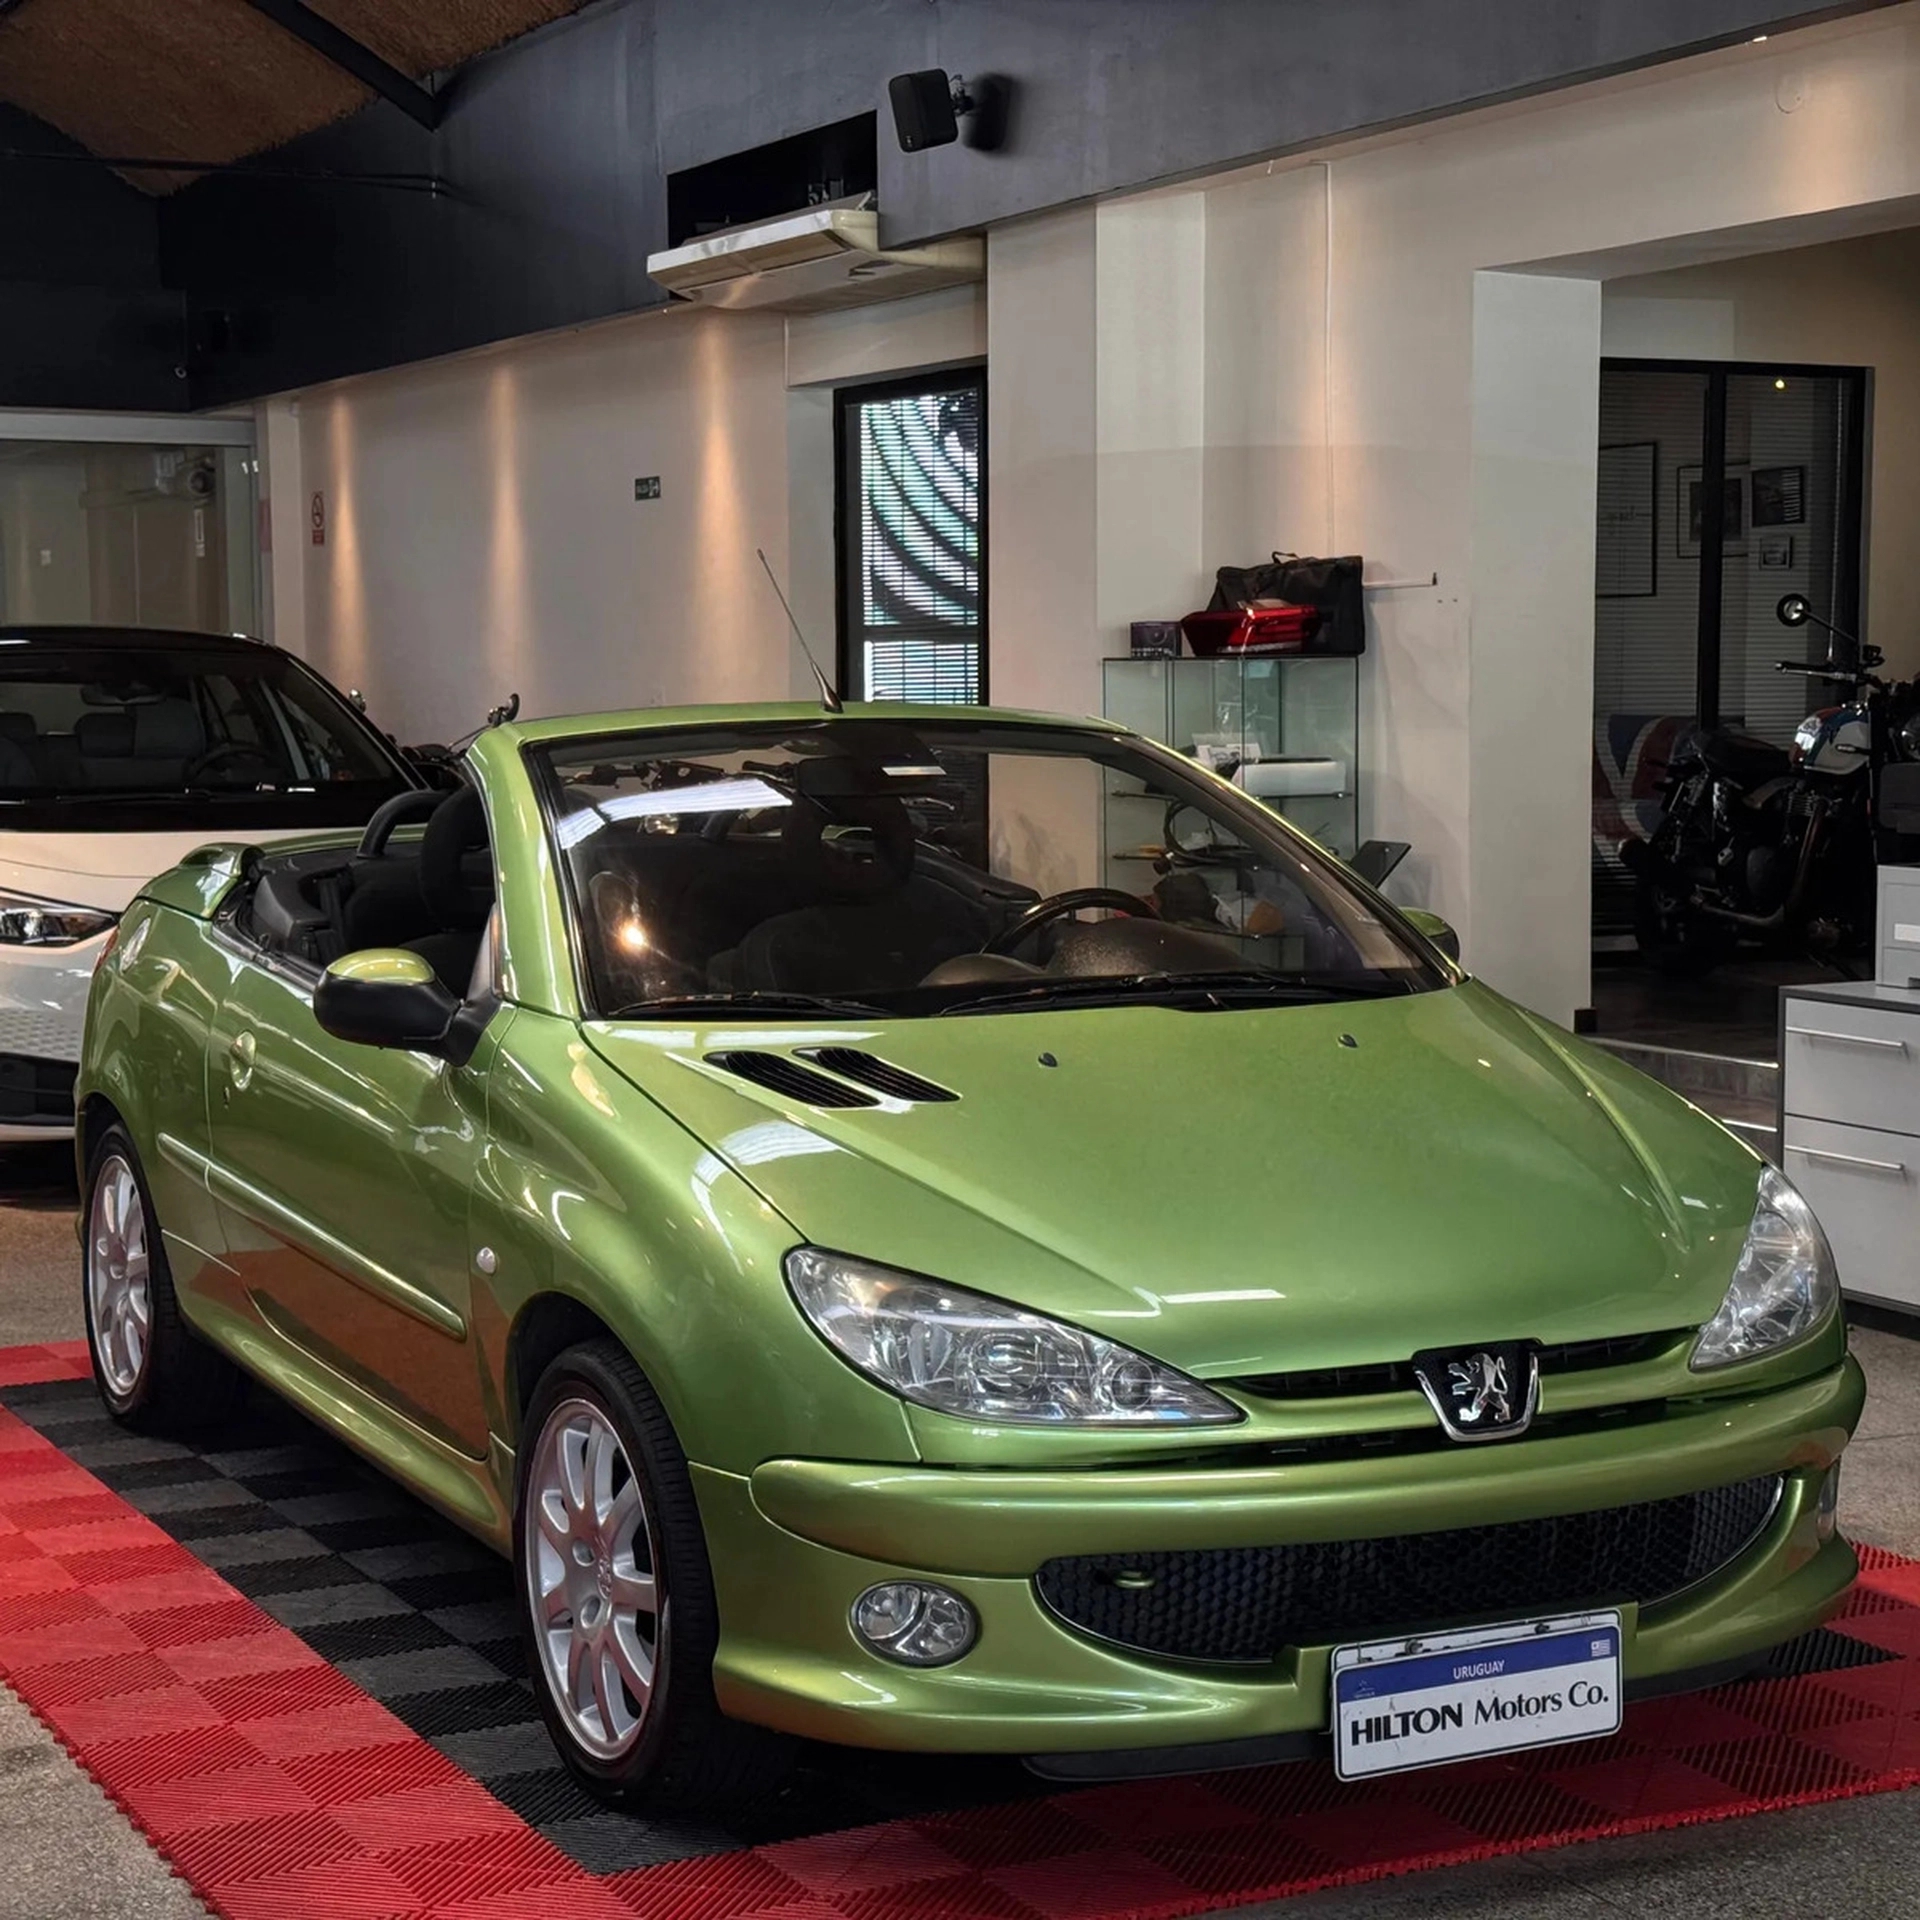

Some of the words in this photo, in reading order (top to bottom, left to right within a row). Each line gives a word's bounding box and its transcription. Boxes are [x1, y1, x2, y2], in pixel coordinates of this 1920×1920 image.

[1453, 1660, 1505, 1680] URUGUAY
[1351, 1702, 1463, 1746] HILTON
[1474, 1692, 1563, 1725] Motors
[1568, 1681, 1609, 1708] Co.
